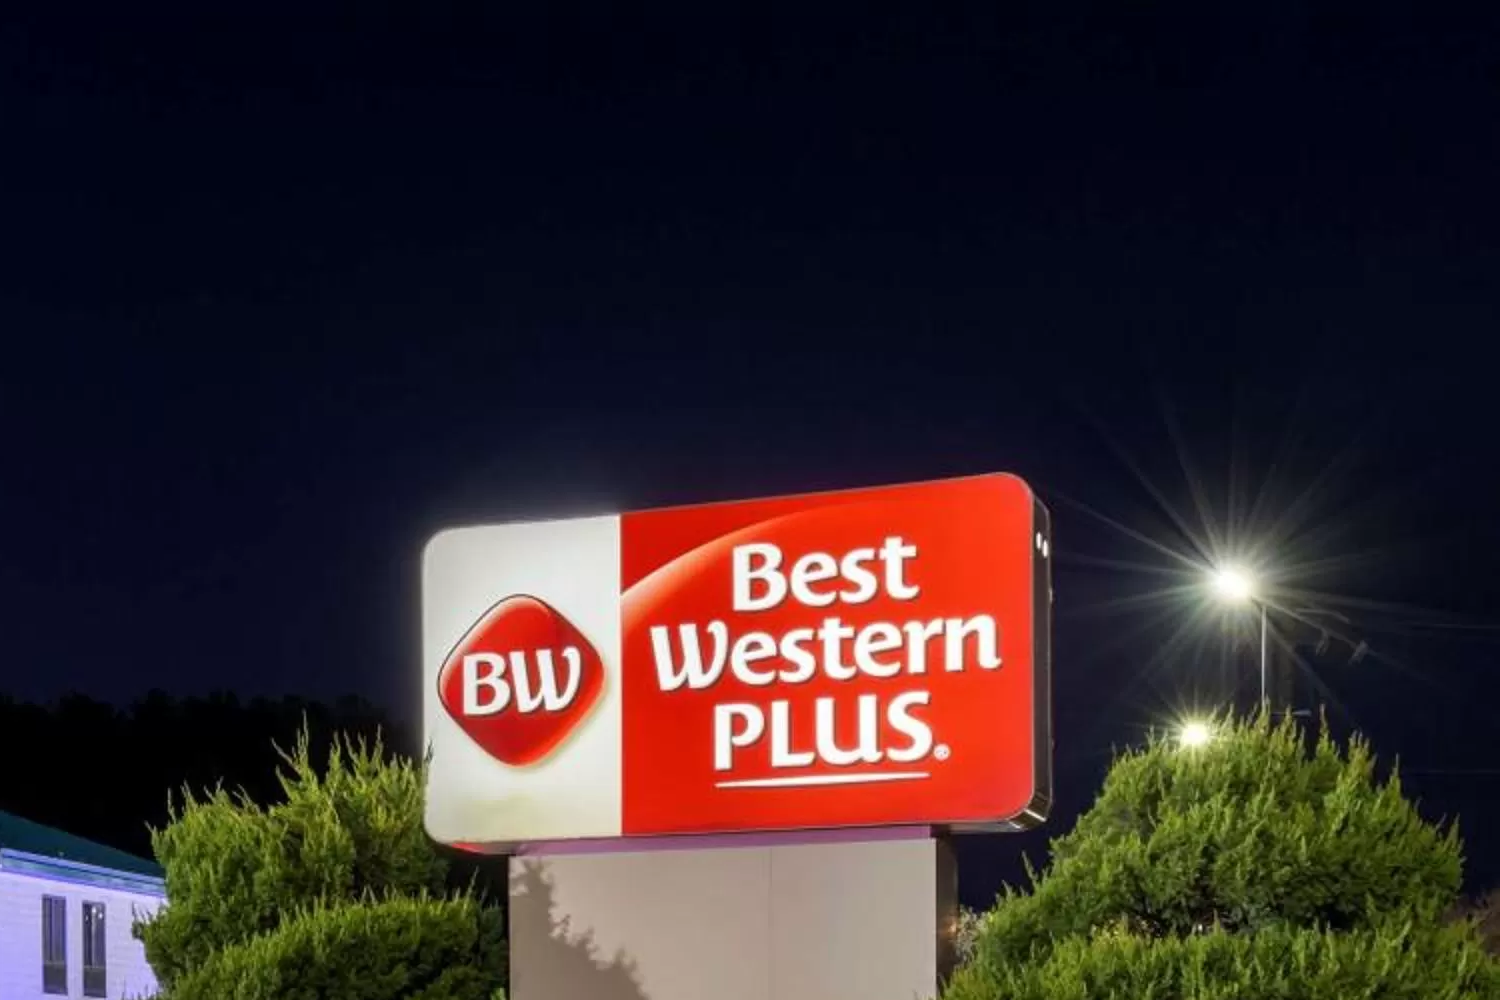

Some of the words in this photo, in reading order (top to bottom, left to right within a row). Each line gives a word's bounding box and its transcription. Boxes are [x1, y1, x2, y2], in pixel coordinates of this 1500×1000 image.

[732, 536, 919, 611] Best
[462, 646, 581, 716] BW
[650, 614, 1002, 691] Western
